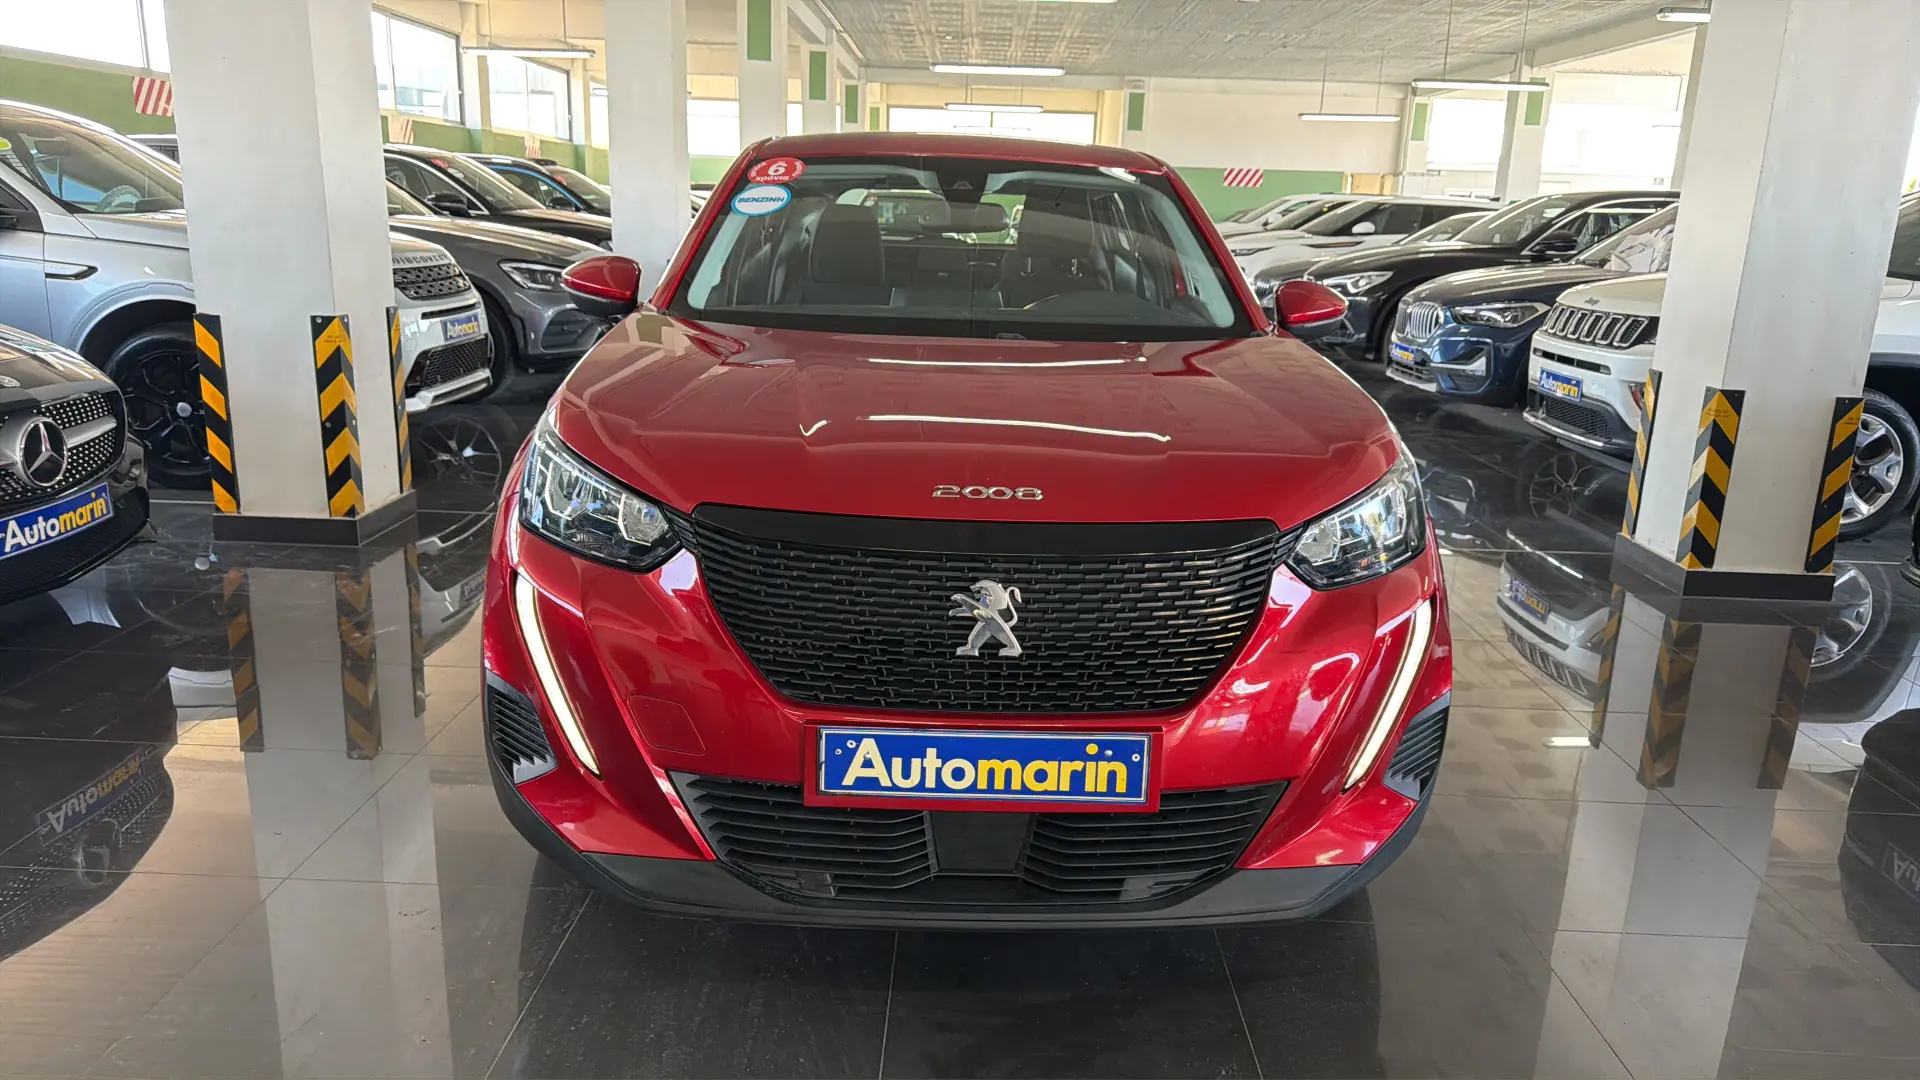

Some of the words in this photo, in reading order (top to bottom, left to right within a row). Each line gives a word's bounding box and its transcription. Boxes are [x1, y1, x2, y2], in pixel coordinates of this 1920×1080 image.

[767, 161, 788, 176] 6
[1539, 371, 1579, 398] Automarin
[931, 485, 1043, 500] 2008
[4, 492, 107, 553] Automarin
[841, 737, 1128, 793] Automarin
